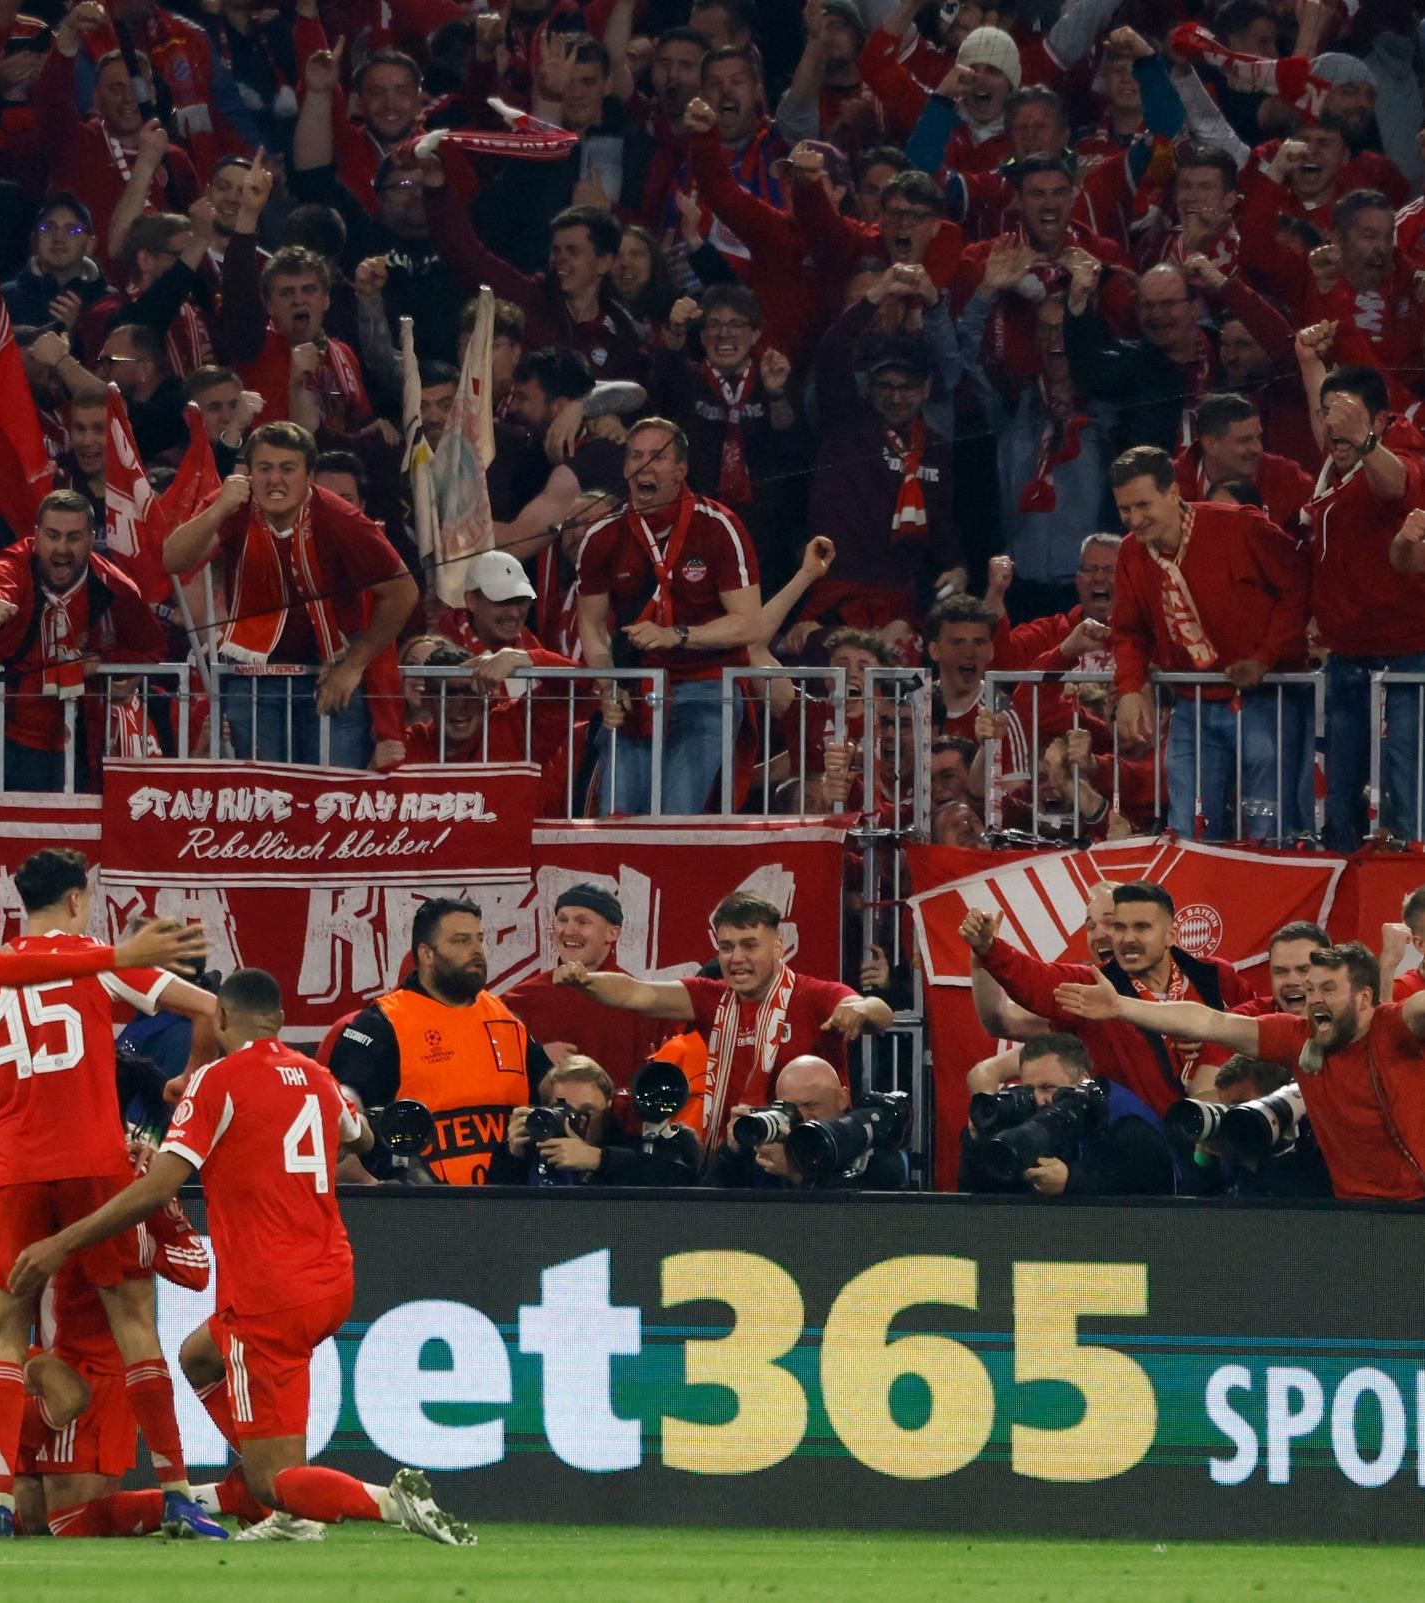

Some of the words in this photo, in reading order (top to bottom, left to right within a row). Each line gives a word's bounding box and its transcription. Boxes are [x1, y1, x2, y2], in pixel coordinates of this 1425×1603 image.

[126, 786, 213, 823] STAY
[215, 788, 295, 823] RUDE
[314, 790, 398, 824] STAY
[398, 791, 498, 824] REBEL
[177, 826, 325, 860] Rebellisch
[327, 827, 452, 860] bleiben!
[1187, 908, 1219, 928] BAYERN
[341, 1026, 375, 1048] SECURITY
[276, 1066, 308, 1087] TAH
[283, 1094, 329, 1194] 4
